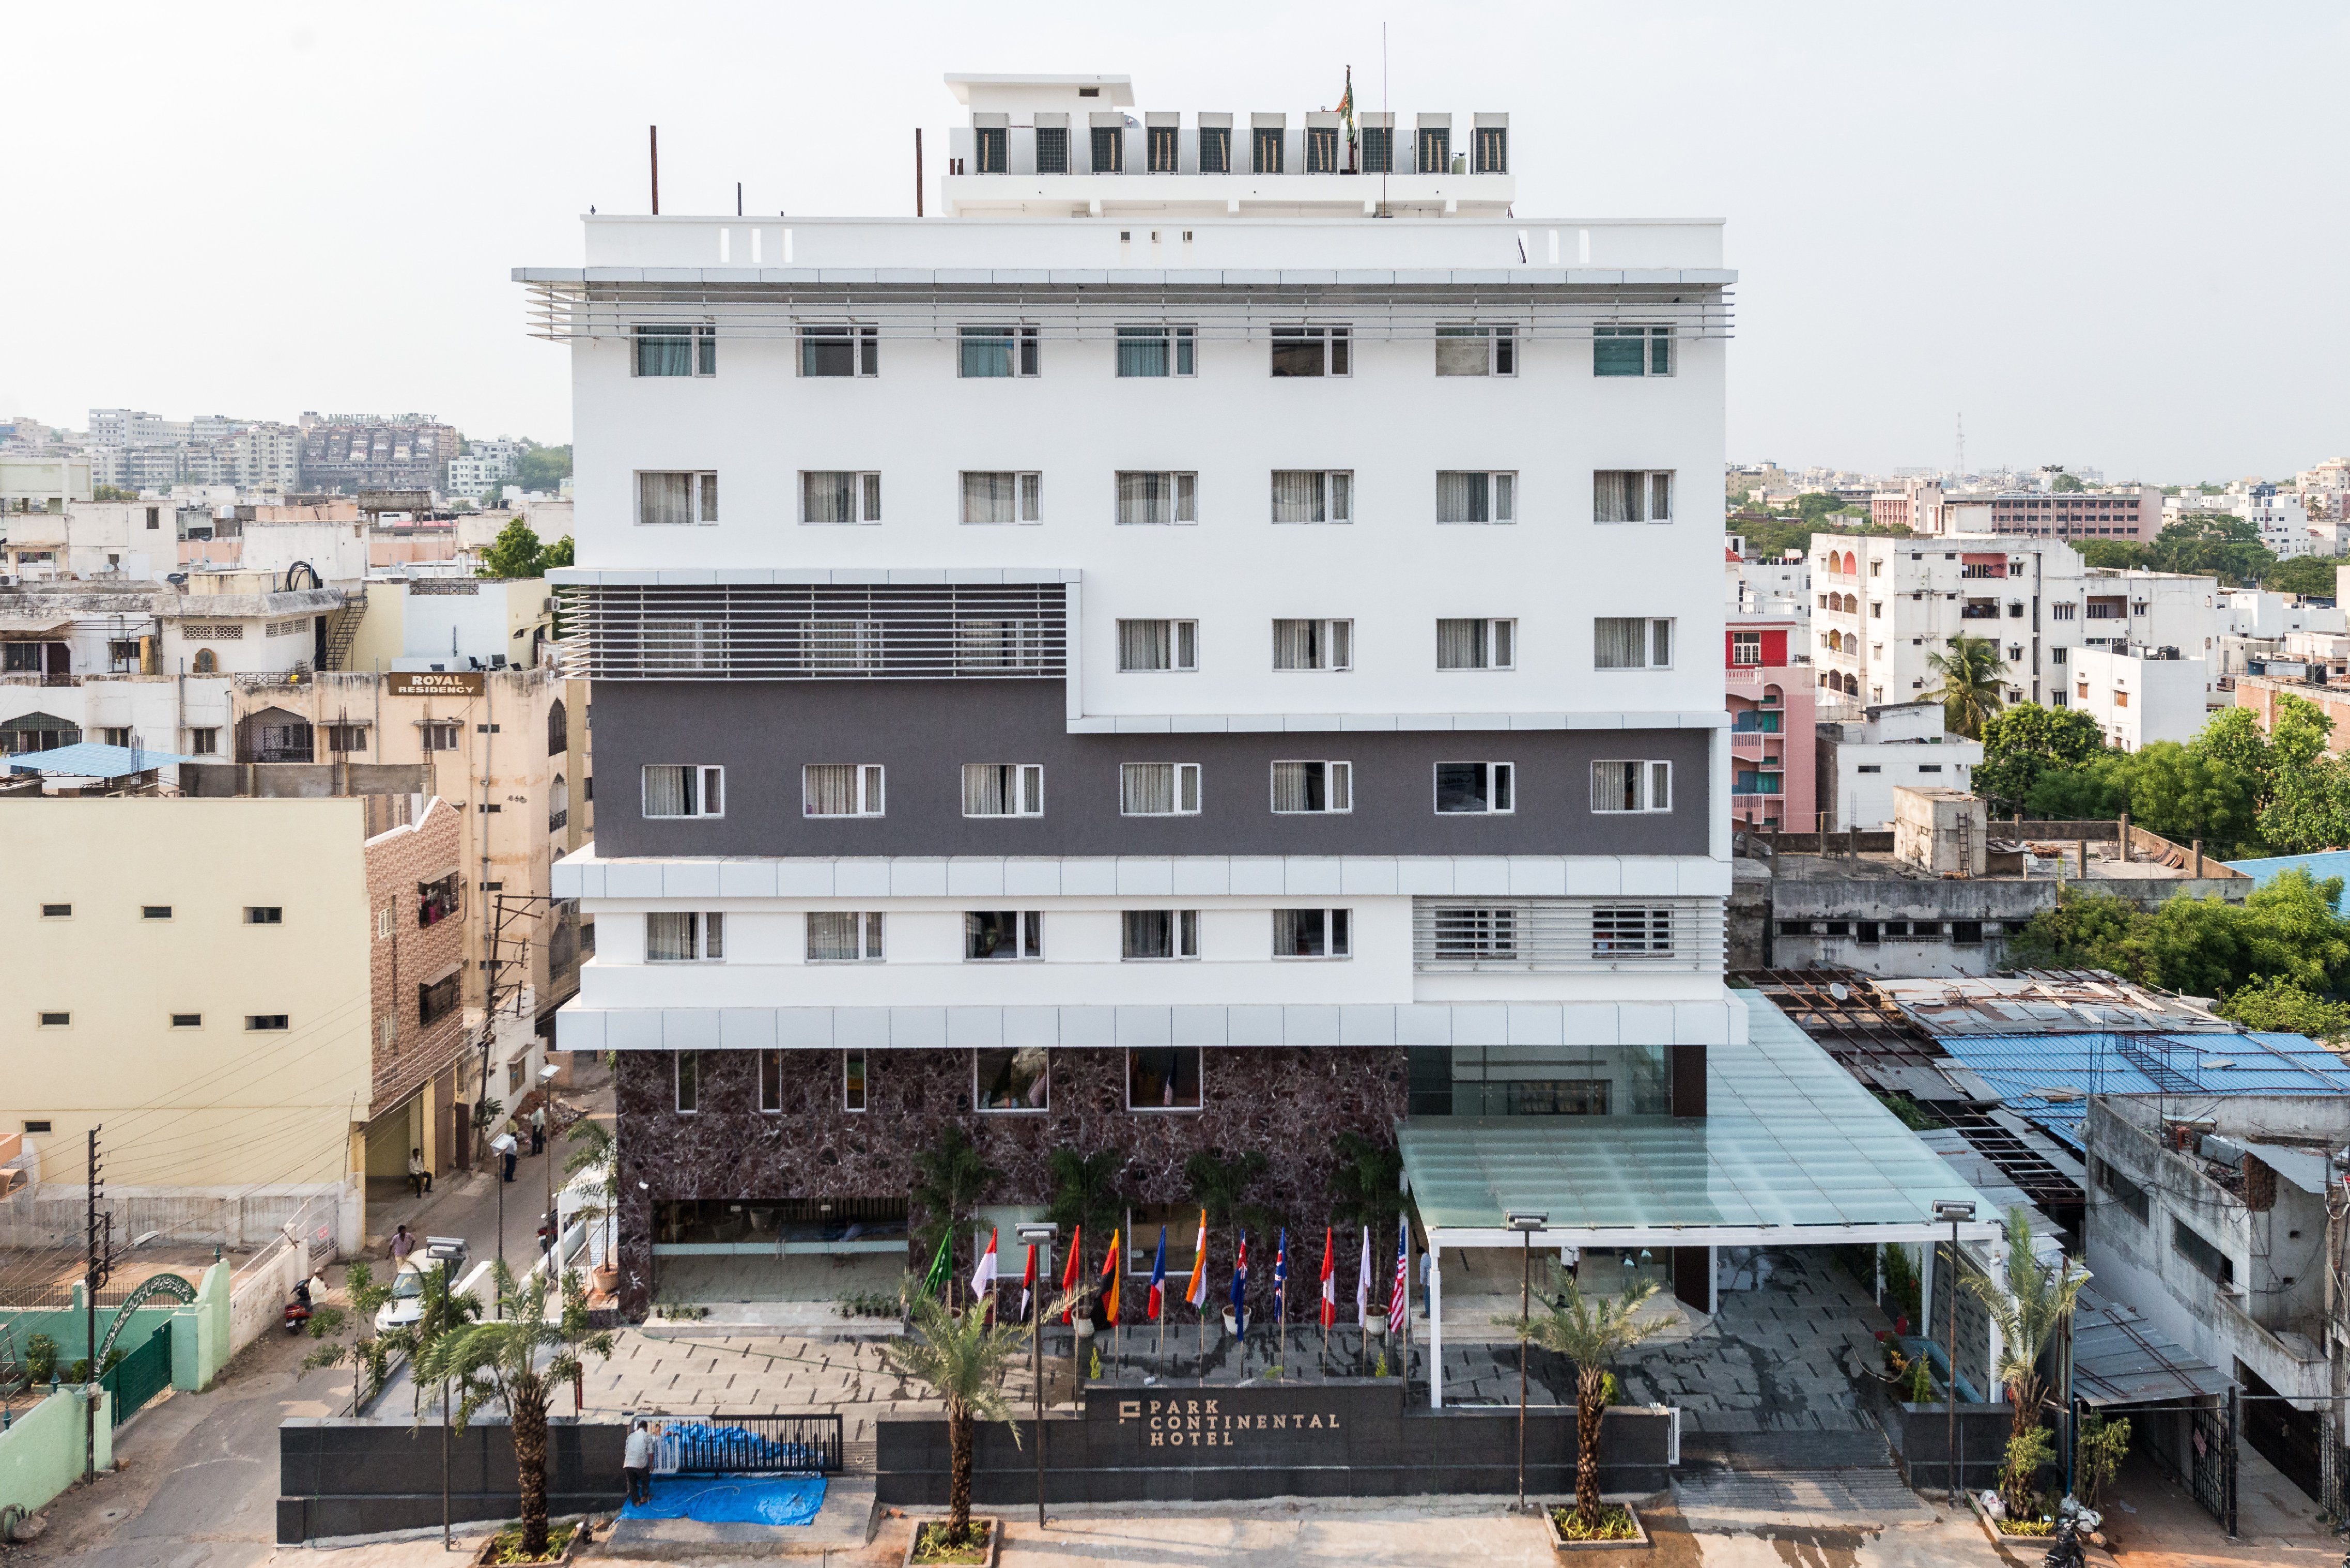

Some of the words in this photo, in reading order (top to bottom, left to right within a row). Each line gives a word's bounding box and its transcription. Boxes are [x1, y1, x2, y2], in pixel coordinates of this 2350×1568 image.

[392, 414, 437, 424] VAEY
[412, 675, 463, 685] ROYAL
[1150, 1400, 1218, 1414] PARK
[1150, 1414, 1340, 1430] CONTINENTAL
[1150, 1432, 1233, 1446] HOTEL
